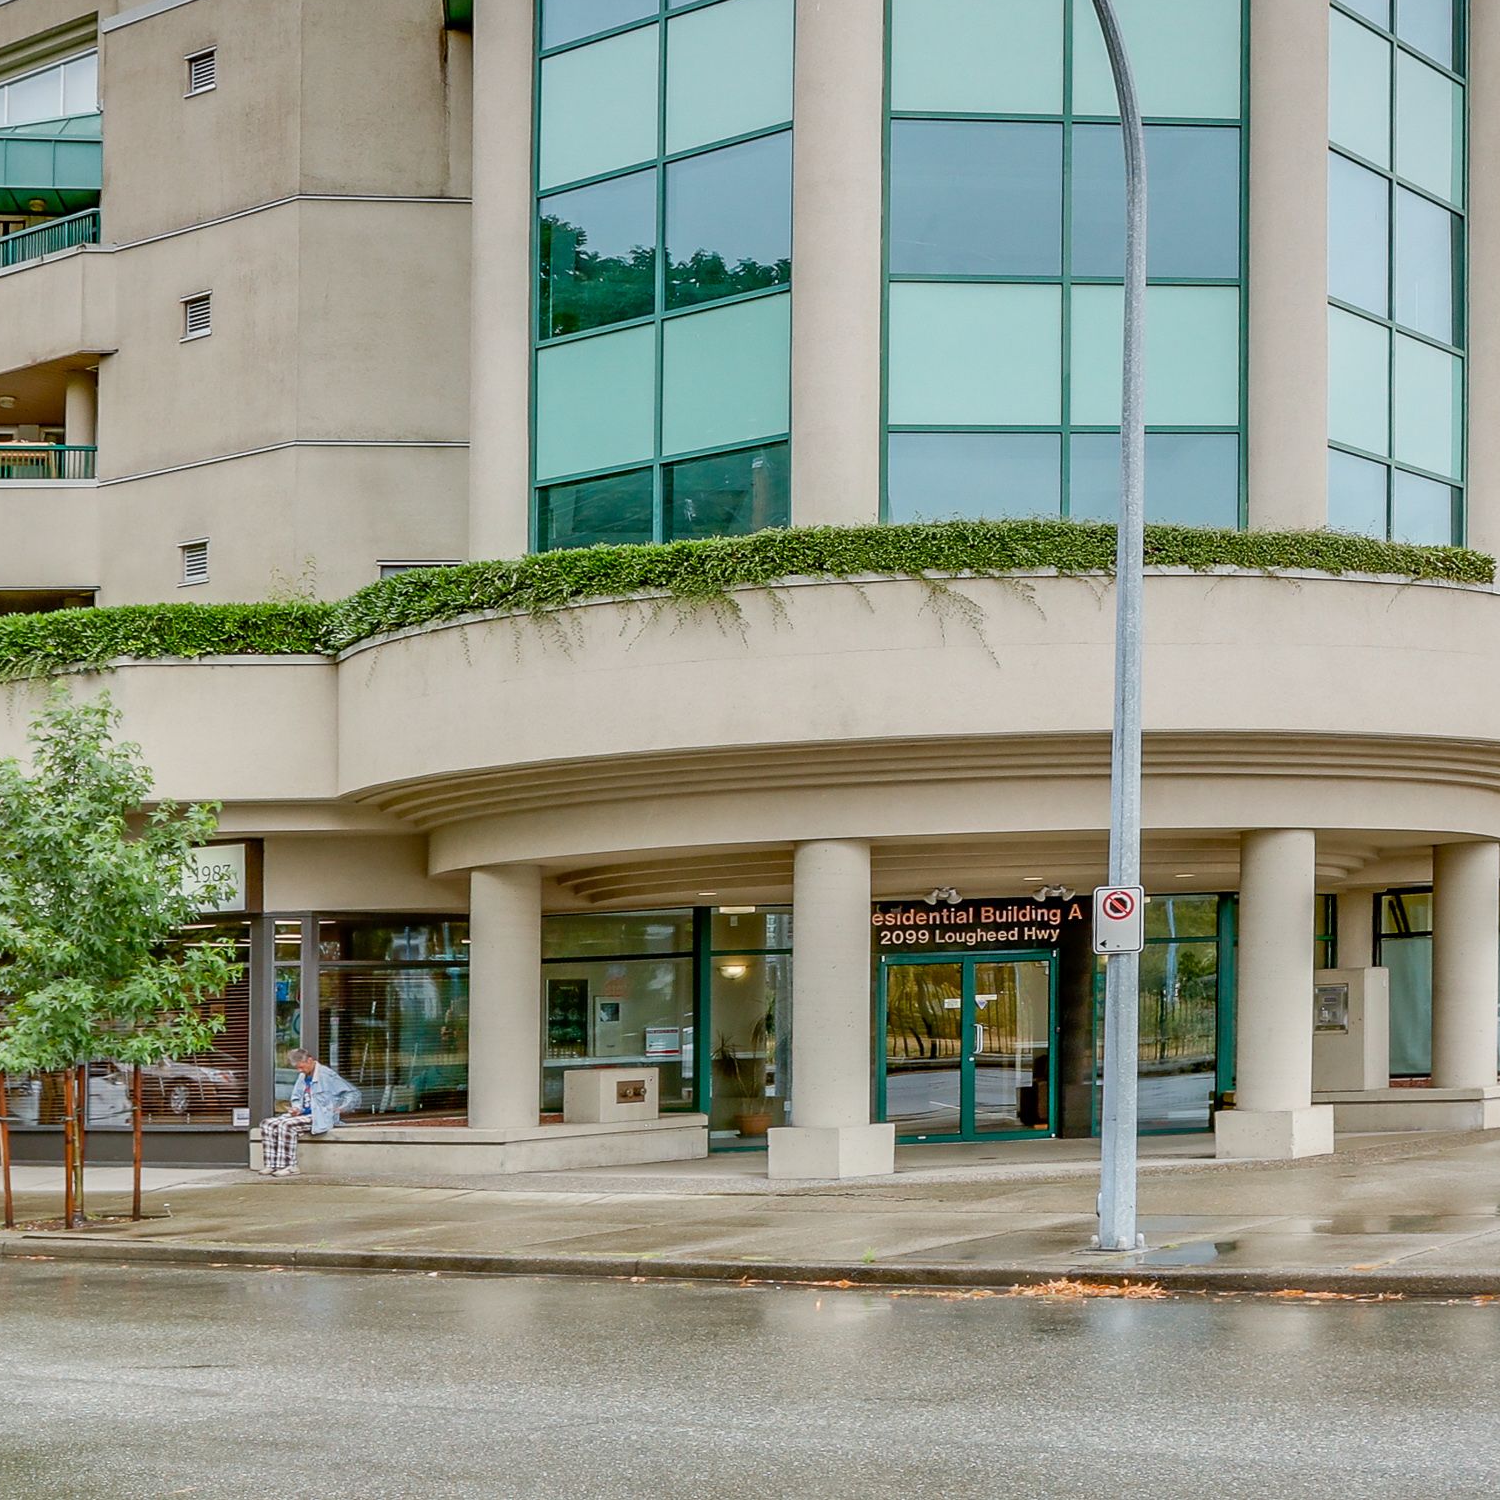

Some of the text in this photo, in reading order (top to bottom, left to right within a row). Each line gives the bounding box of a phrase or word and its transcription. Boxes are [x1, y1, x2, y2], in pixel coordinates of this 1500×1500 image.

[871, 903, 1083, 926] esidential Building A
[880, 926, 1060, 946] 2099 Lougheed Hwy
